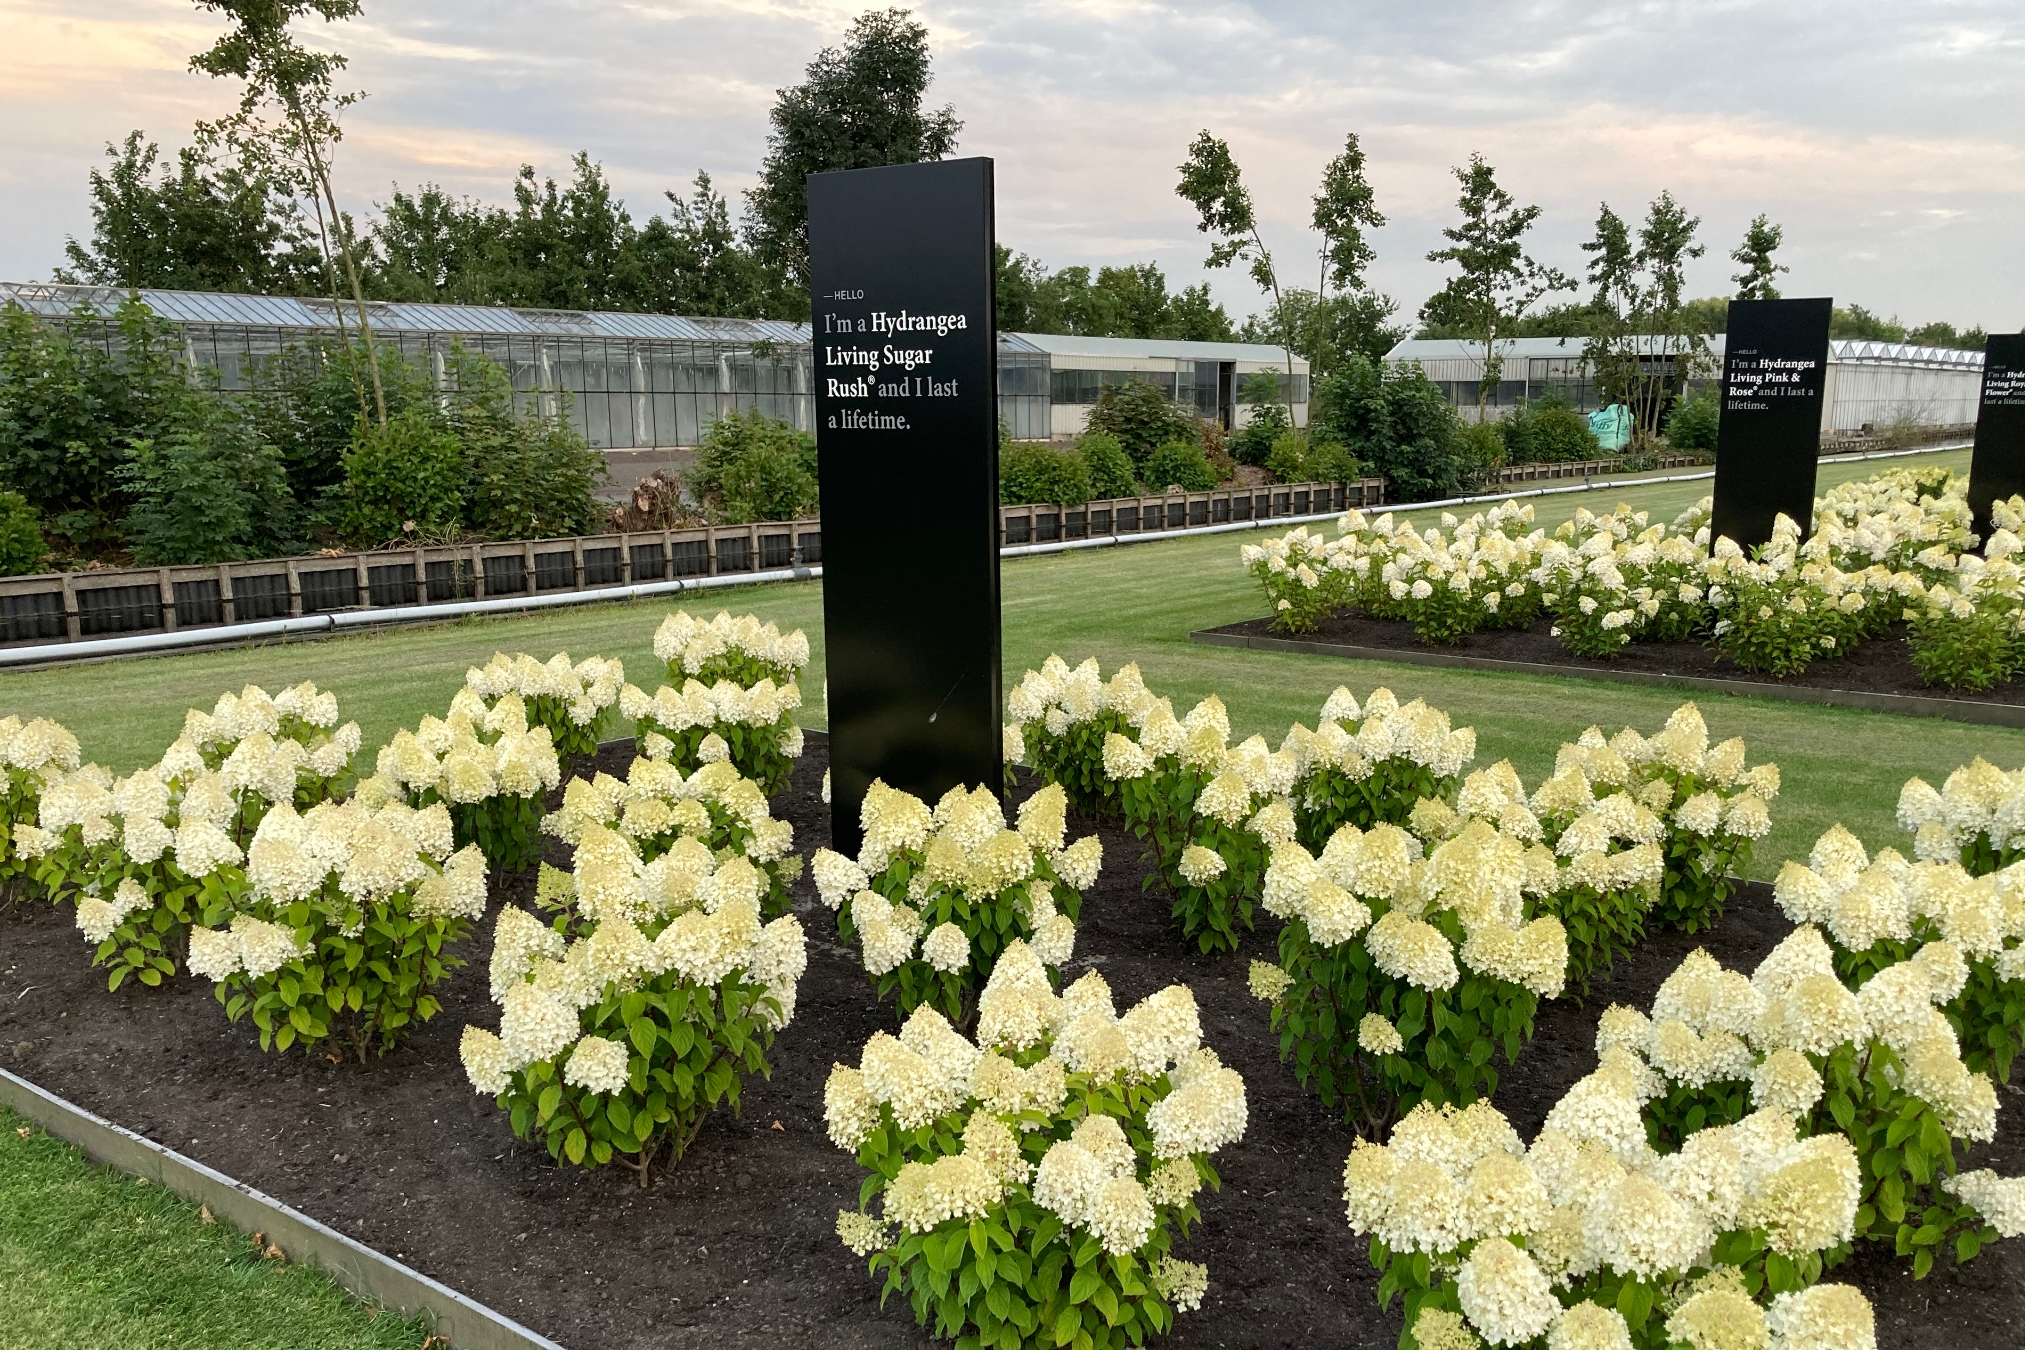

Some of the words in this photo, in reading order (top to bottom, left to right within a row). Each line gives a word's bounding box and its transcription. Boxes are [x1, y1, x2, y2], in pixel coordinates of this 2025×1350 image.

[857, 318, 867, 332] a
[871, 310, 967, 338] Hydrangea
[825, 346, 879, 371] Living
[883, 345, 933, 370] Sugar
[1751, 361, 1757, 369] a
[1759, 358, 1815, 371] Hydrangea
[1730, 373, 1763, 385] Living
[1765, 372, 1789, 383] Pink
[1790, 372, 1800, 382] &
[2011, 380, 2025, 389] Roy
[878, 376, 910, 397] and
[915, 377, 922, 397] I
[927, 376, 958, 397] last
[1758, 386, 1777, 396] and
[1780, 386, 1785, 396] I
[1787, 386, 1805, 396] last
[1727, 400, 1769, 410] lifetime.
[828, 415, 837, 429] a
[841, 409, 911, 429] lifetime.
